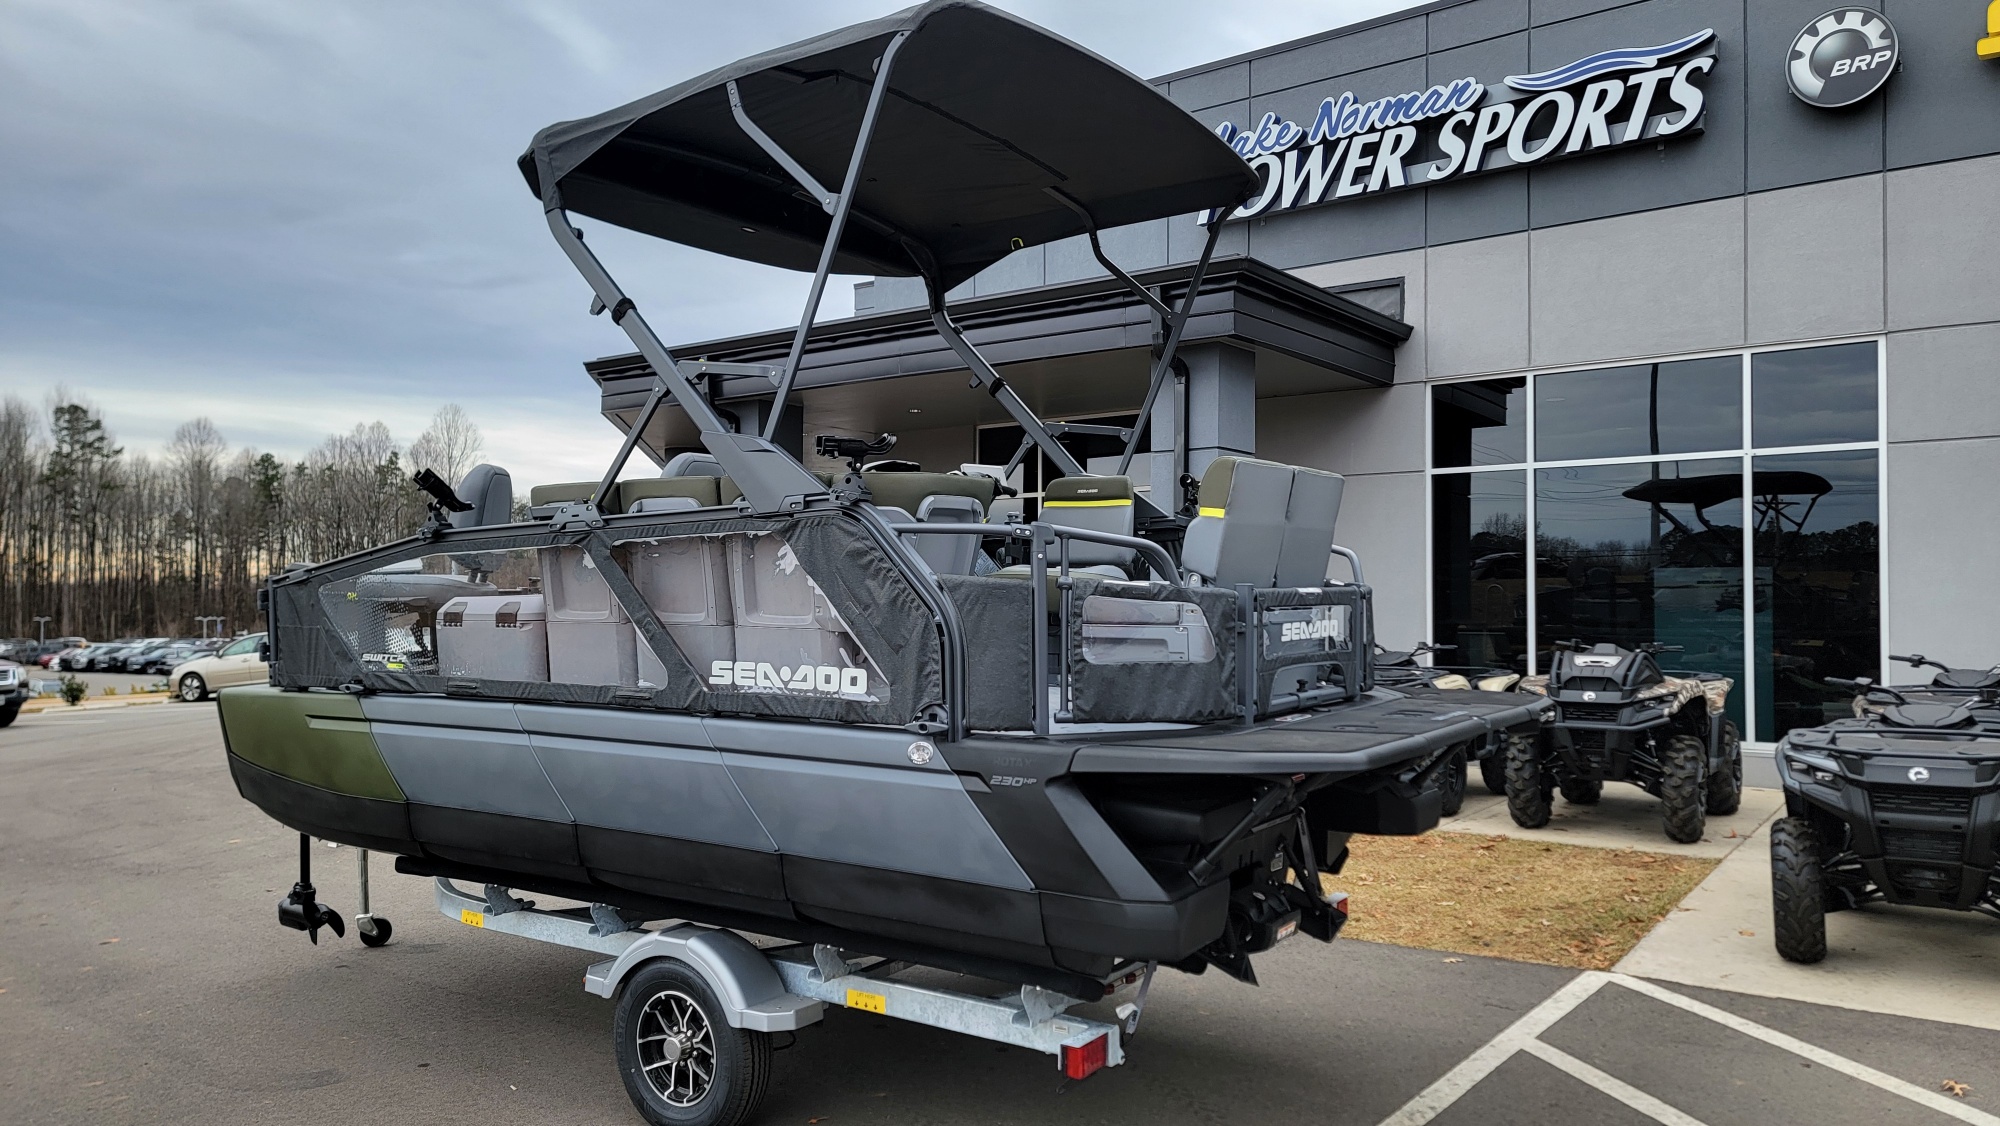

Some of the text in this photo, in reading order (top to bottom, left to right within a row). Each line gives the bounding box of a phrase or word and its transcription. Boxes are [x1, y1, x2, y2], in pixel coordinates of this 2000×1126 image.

[1829, 50, 1892, 77] BRP
[1197, 57, 1715, 226] OWER SPORTS
[1307, 76, 1486, 145] Norman
